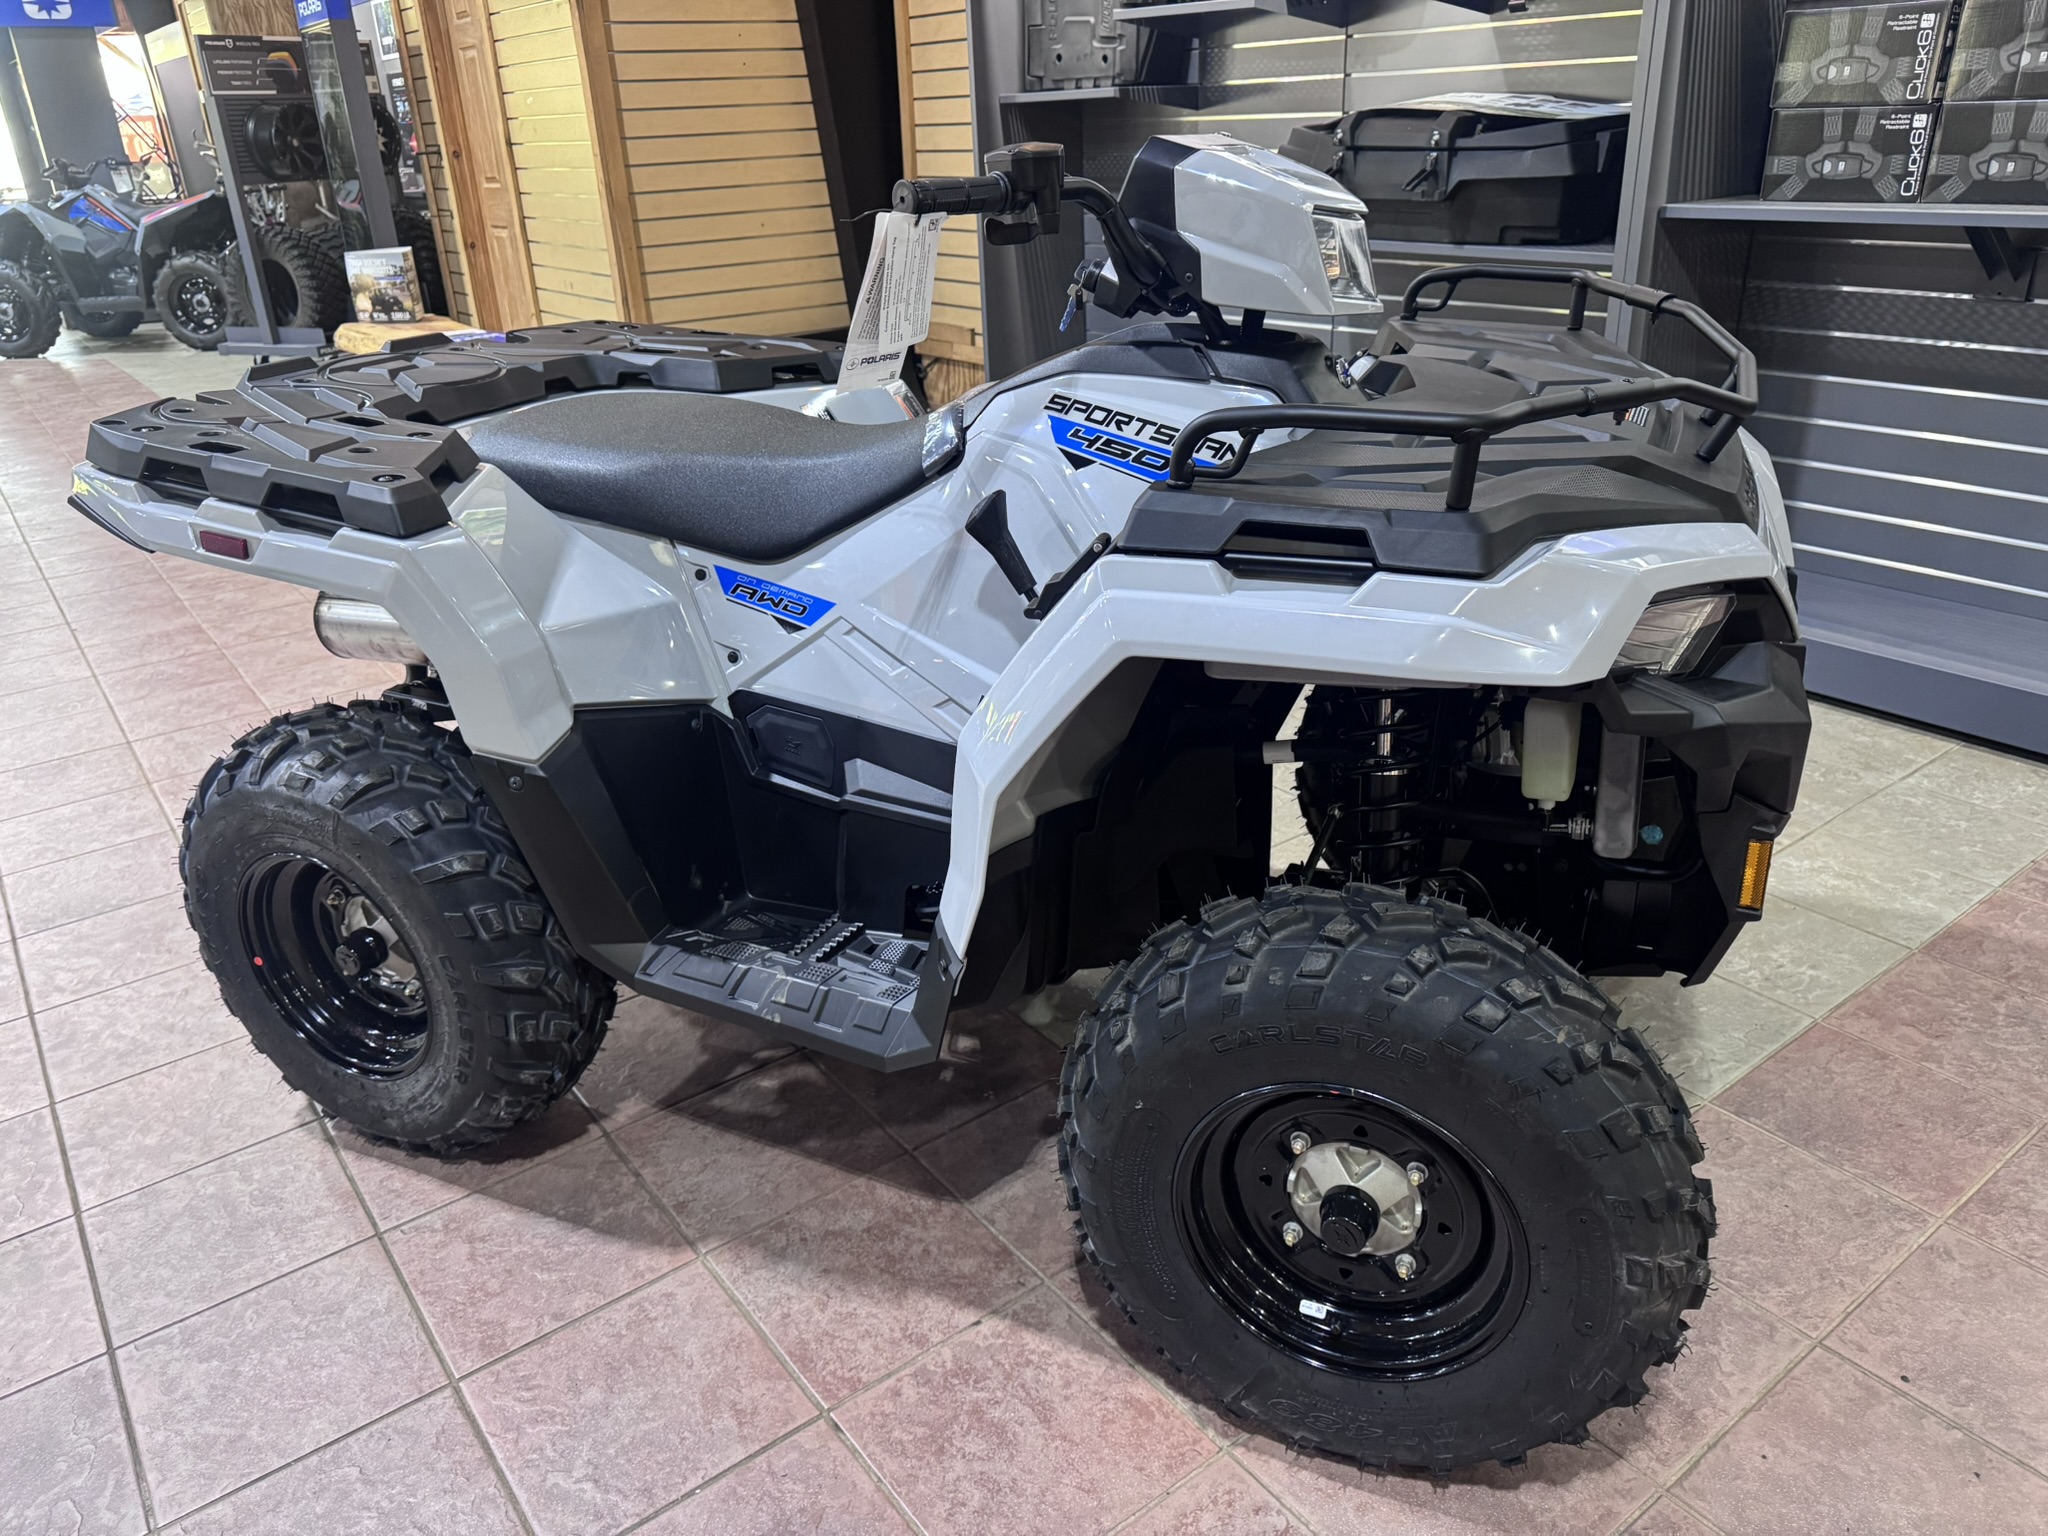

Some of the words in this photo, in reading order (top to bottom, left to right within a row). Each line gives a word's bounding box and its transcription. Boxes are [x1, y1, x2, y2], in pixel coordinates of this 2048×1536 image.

[867, 257, 885, 296] WARNING
[860, 352, 901, 366] POLARIS
[1043, 393, 1237, 461] SPORTSAN
[1067, 427, 1171, 473] 450
[729, 583, 810, 617] AWD
[438, 953, 474, 1085] CARLSTAR
[1208, 1024, 1431, 1072] CARLSTAR
